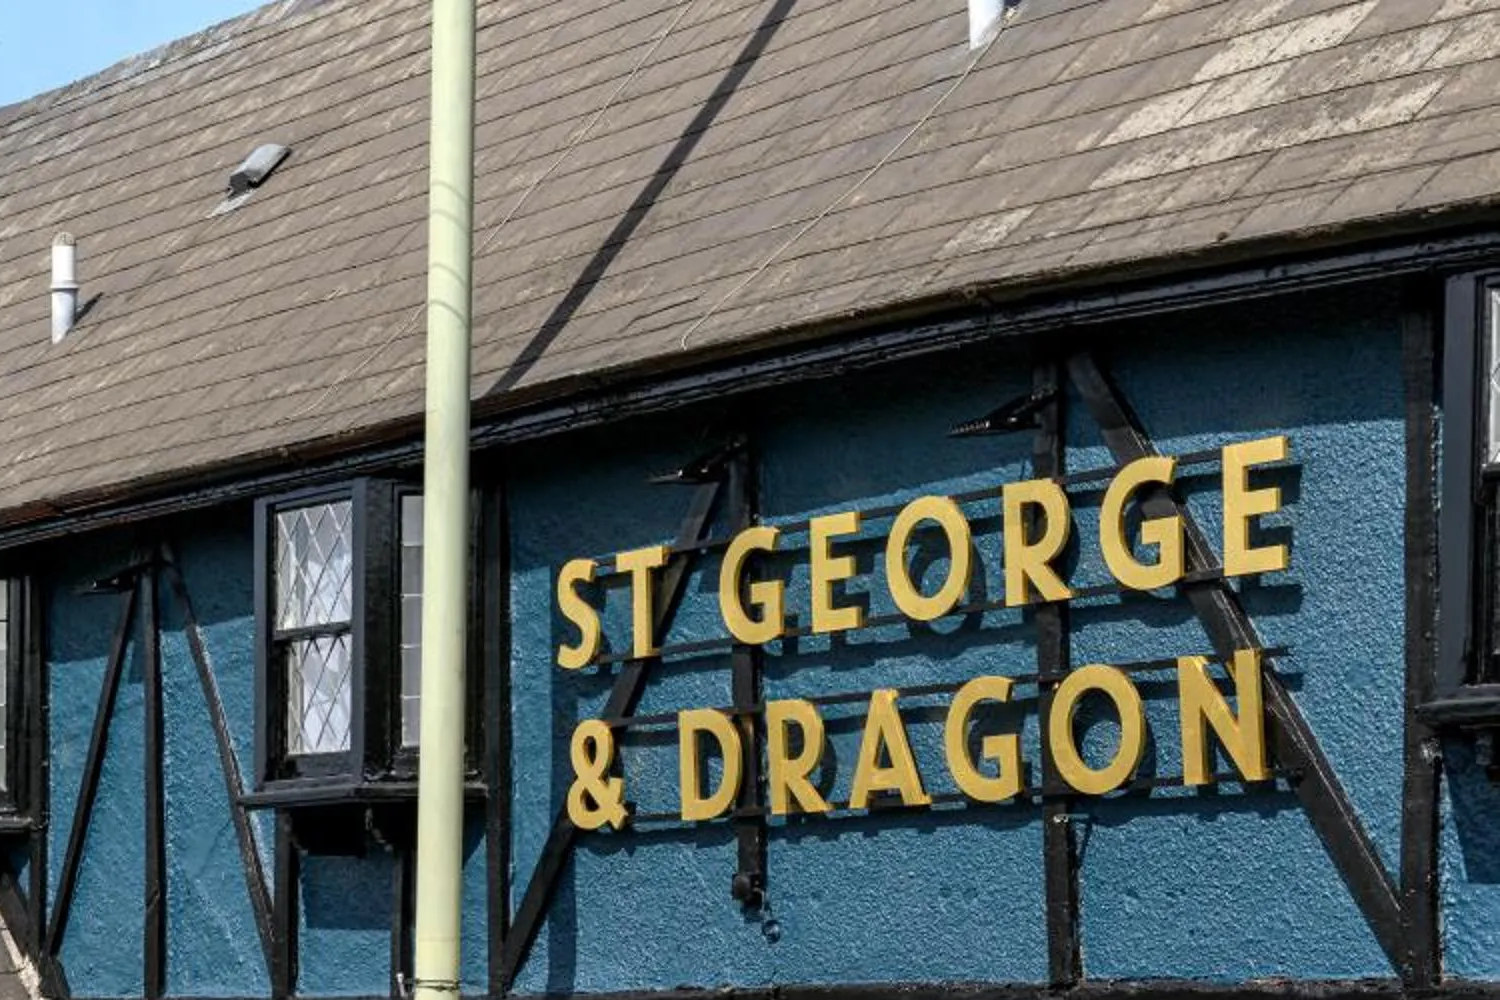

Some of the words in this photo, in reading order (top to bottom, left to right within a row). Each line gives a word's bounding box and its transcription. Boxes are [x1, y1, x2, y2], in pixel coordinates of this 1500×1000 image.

[556, 545, 672, 670] ST
[718, 435, 1291, 645] GEORGE
[566, 718, 628, 831] &
[677, 648, 1273, 822] DRAGON
